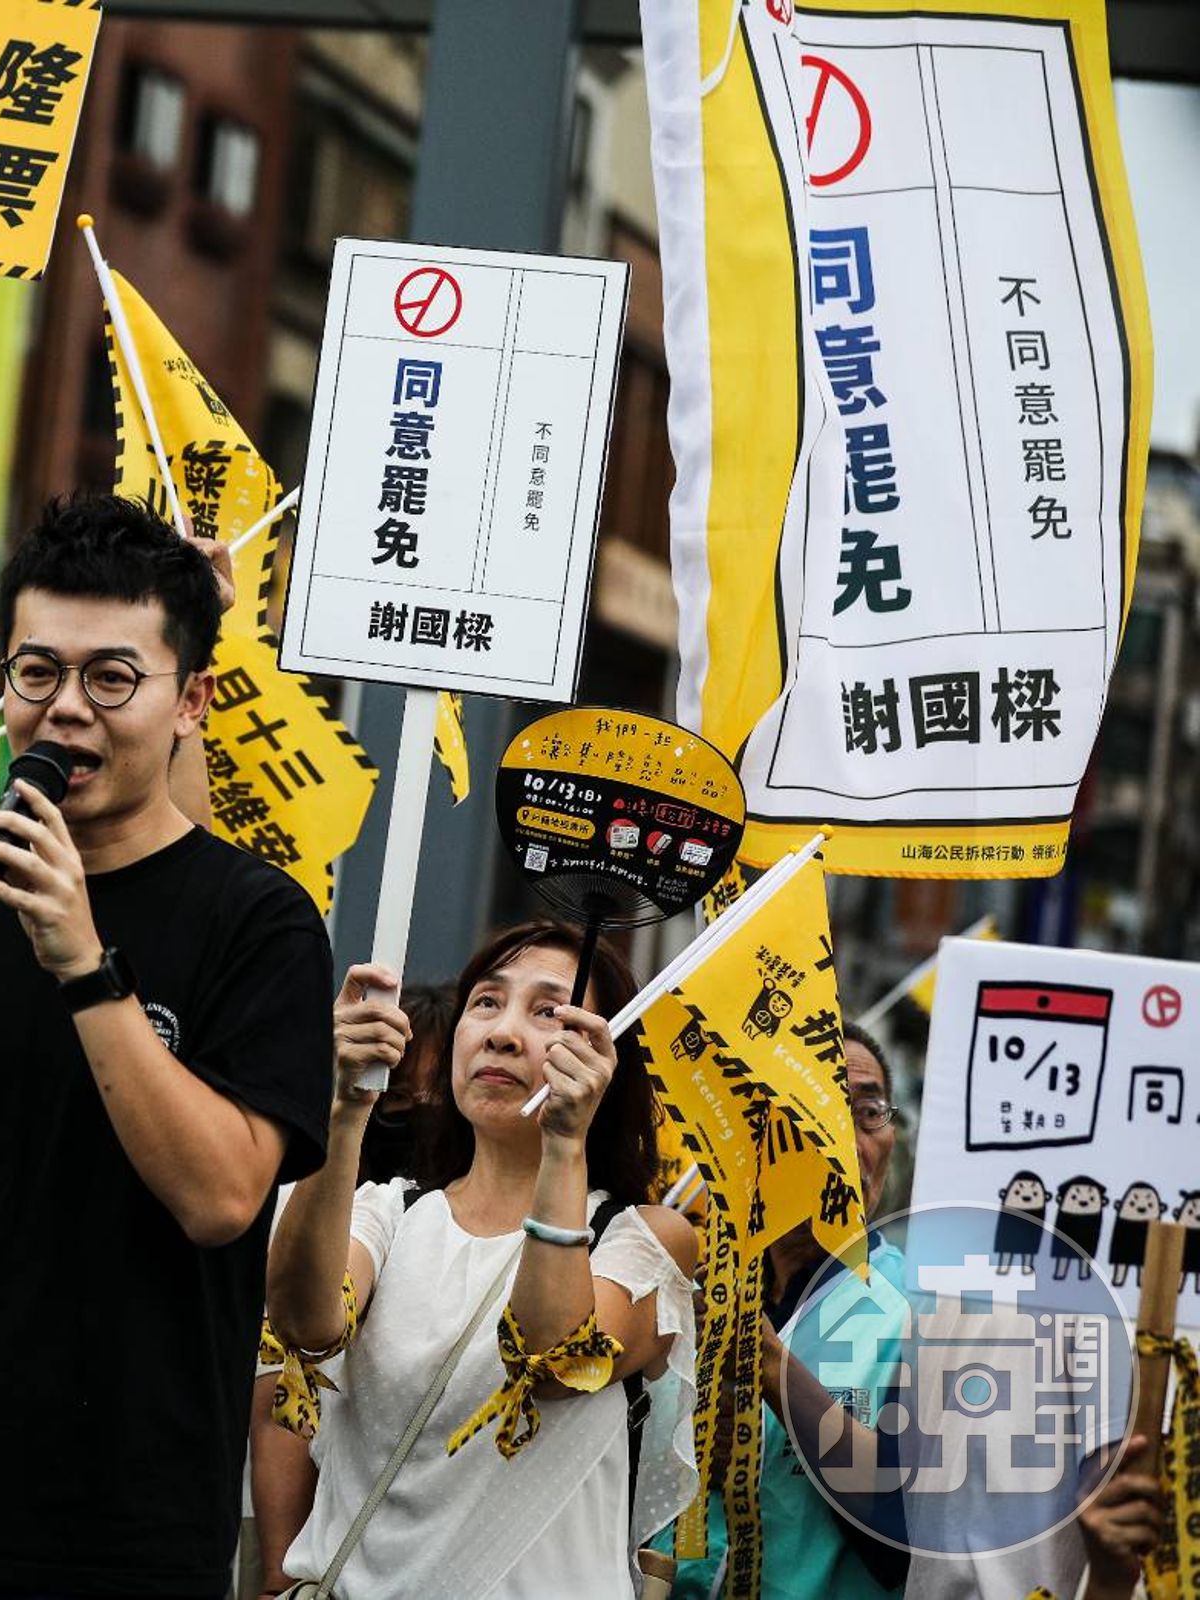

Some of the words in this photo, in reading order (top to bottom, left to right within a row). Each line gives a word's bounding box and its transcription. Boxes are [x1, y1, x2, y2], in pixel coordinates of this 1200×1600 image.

[998, 276, 1072, 540] 不同意罷免
[370, 357, 443, 569] 同意罷免
[524, 421, 553, 532] 不同意罷免
[367, 600, 495, 652] 謝國樑
[840, 666, 1062, 755] 謝國樑
[902, 844, 1025, 861] 山海公民拆樑行動
[988, 1035, 1081, 1097] 10/13
